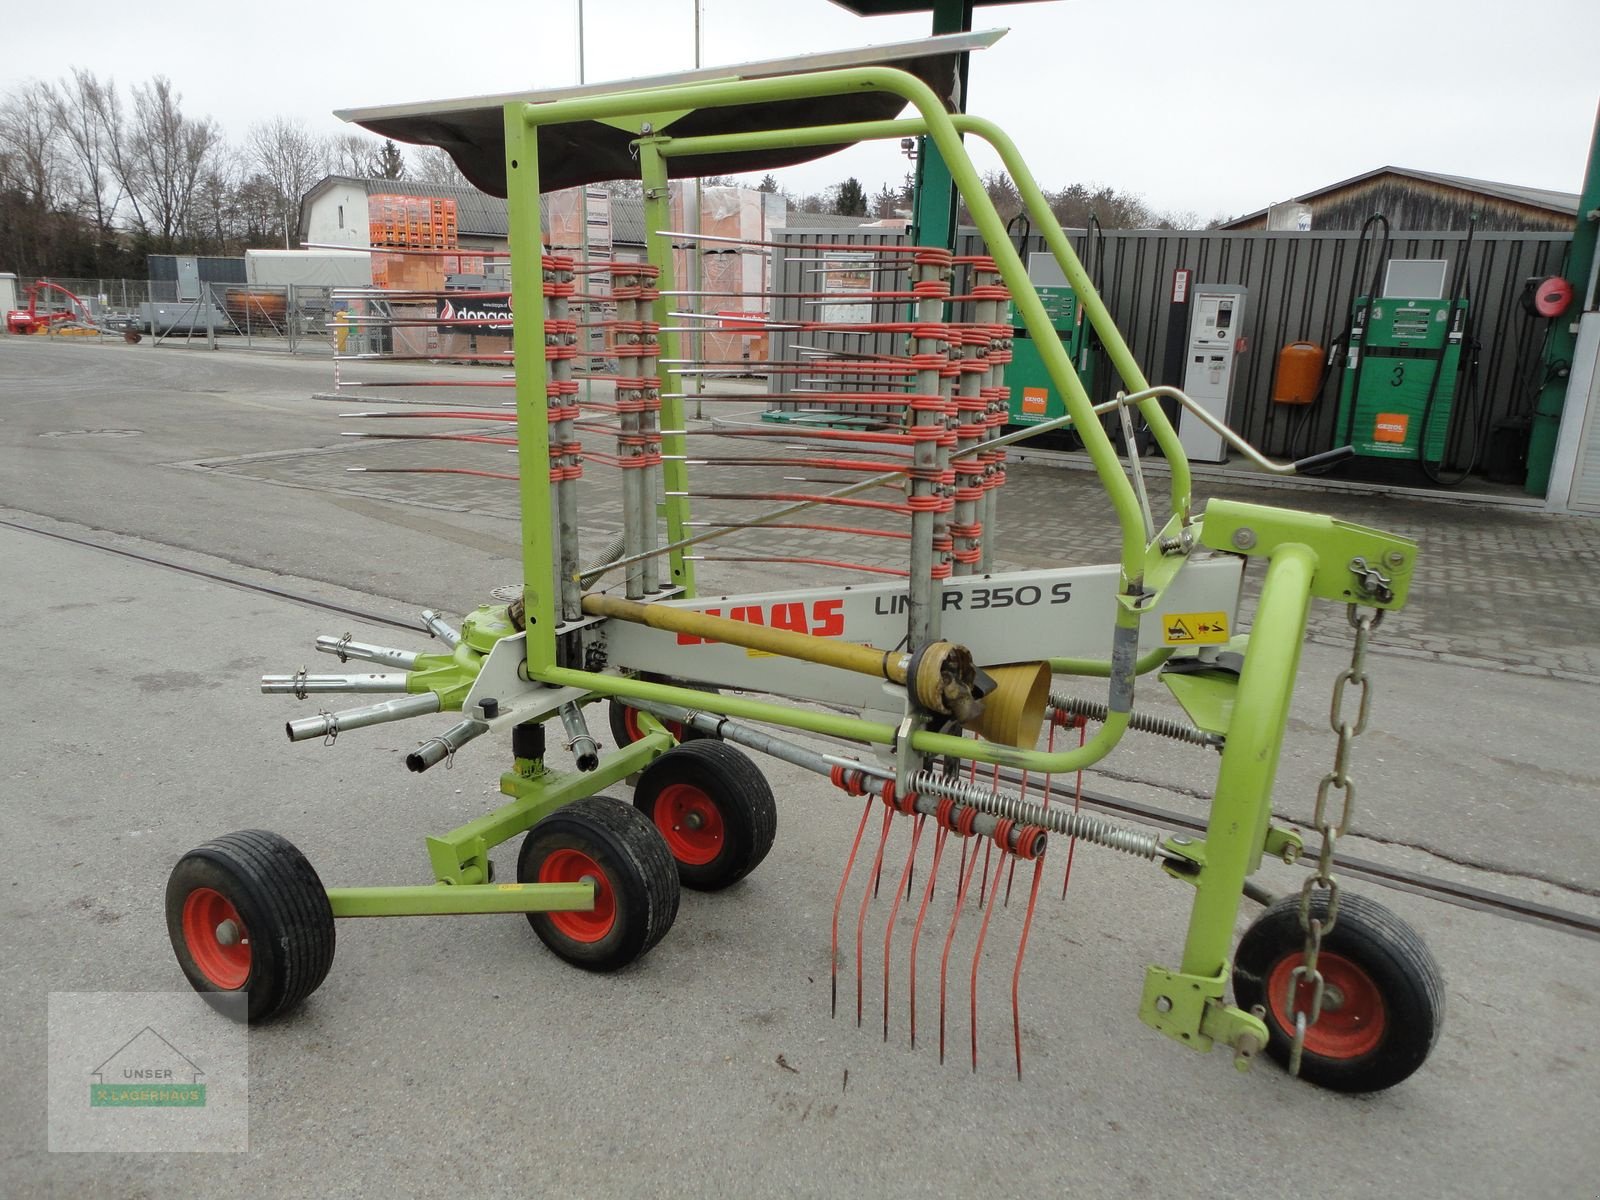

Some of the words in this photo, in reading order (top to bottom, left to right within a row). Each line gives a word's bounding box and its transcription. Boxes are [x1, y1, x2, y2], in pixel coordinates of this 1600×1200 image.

[1391, 367, 1404, 387] 3
[875, 590, 963, 615] LINR
[970, 585, 1042, 609] 350
[1050, 582, 1072, 604] S
[677, 599, 844, 645] AAS
